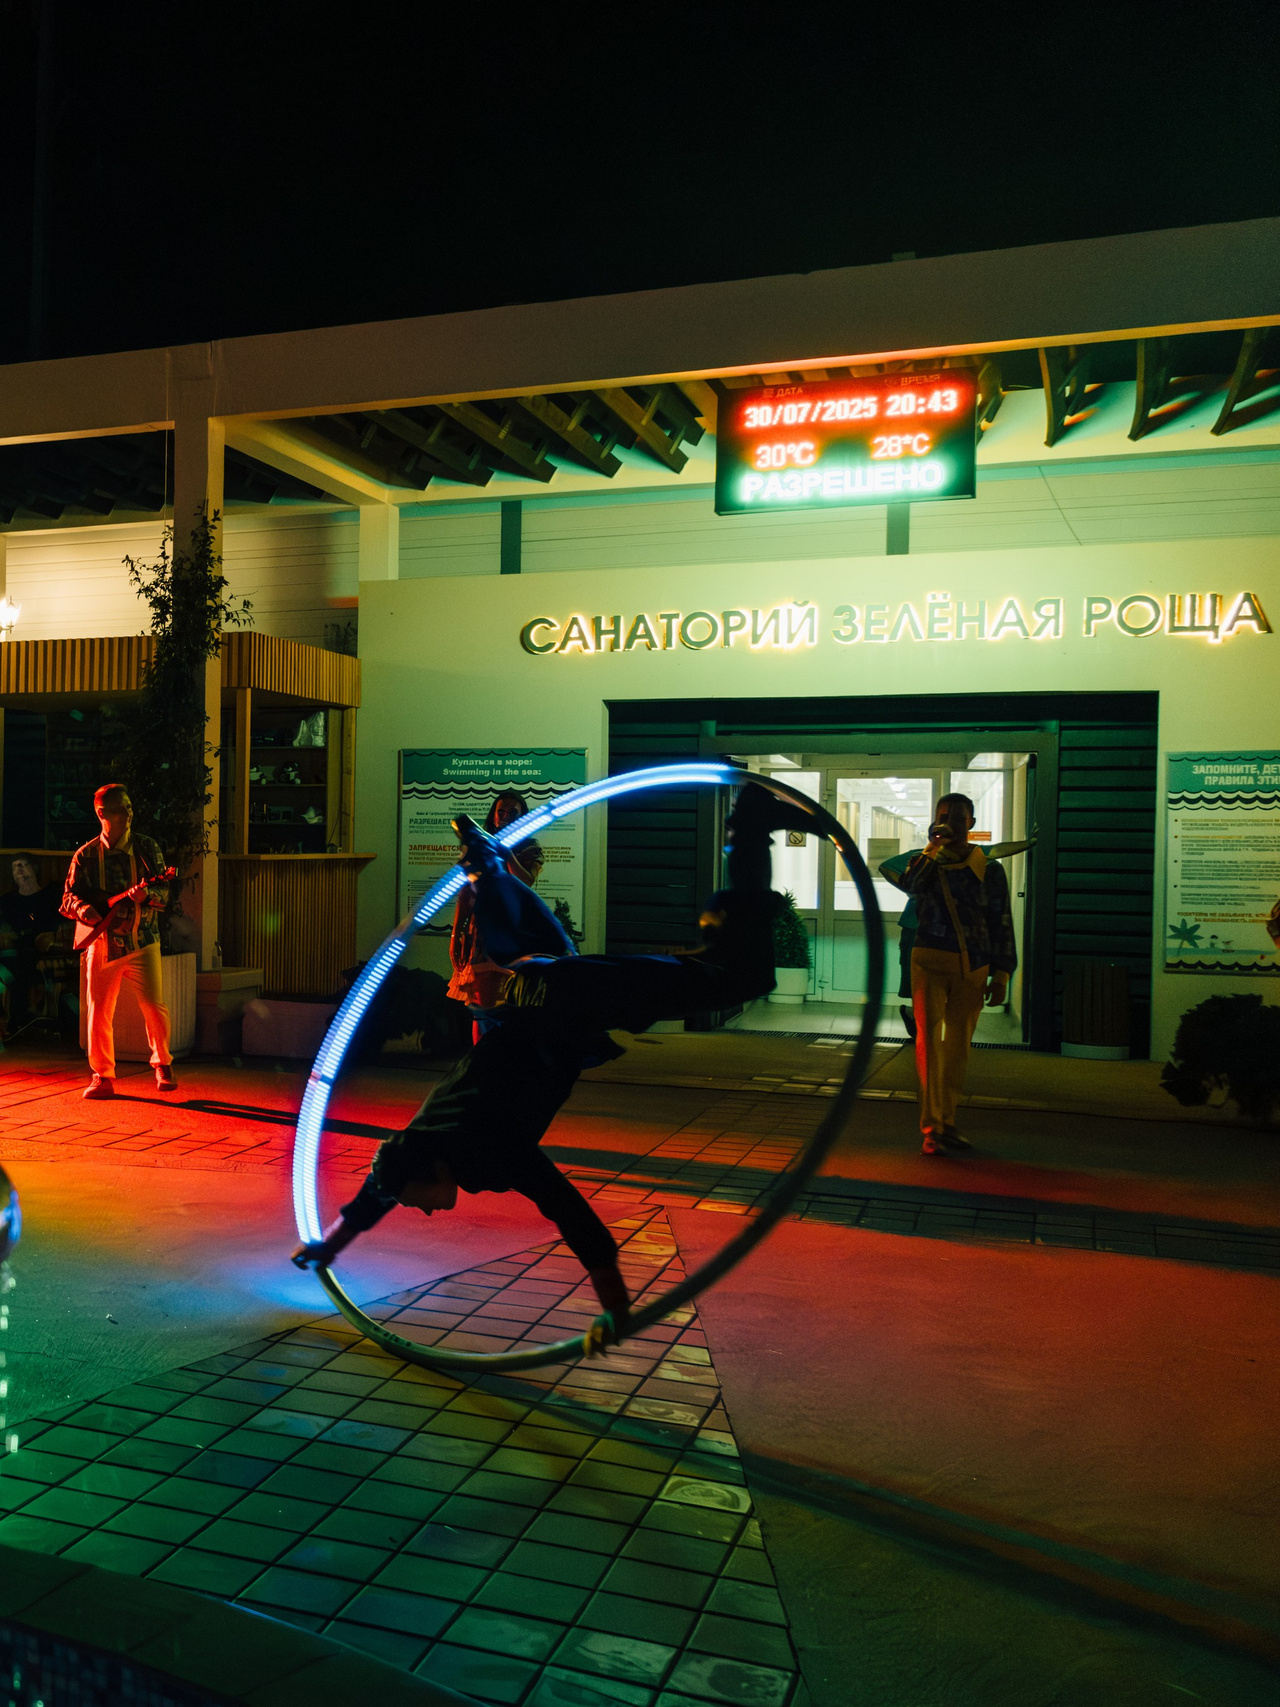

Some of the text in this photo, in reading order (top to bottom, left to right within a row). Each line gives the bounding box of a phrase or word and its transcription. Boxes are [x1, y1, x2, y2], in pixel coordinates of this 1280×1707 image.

[776, 386, 804, 397] ДАТА
[744, 389, 958, 428] 30/07/2025 20:43
[741, 463, 943, 501] РАЗРЕШЕНО
[520, 591, 1274, 655] САНАТОРИЙ ЗЕЛЁНАЯ РОЩА
[452, 758, 495, 768] Купаться
[505, 759, 533, 767] море:
[442, 768, 542, 777] Swimming in the sea:
[1192, 764, 1260, 775] ЗАПОМНИТЕ,
[1204, 776, 1280, 785] ПРАВИЛА ЭТИ
